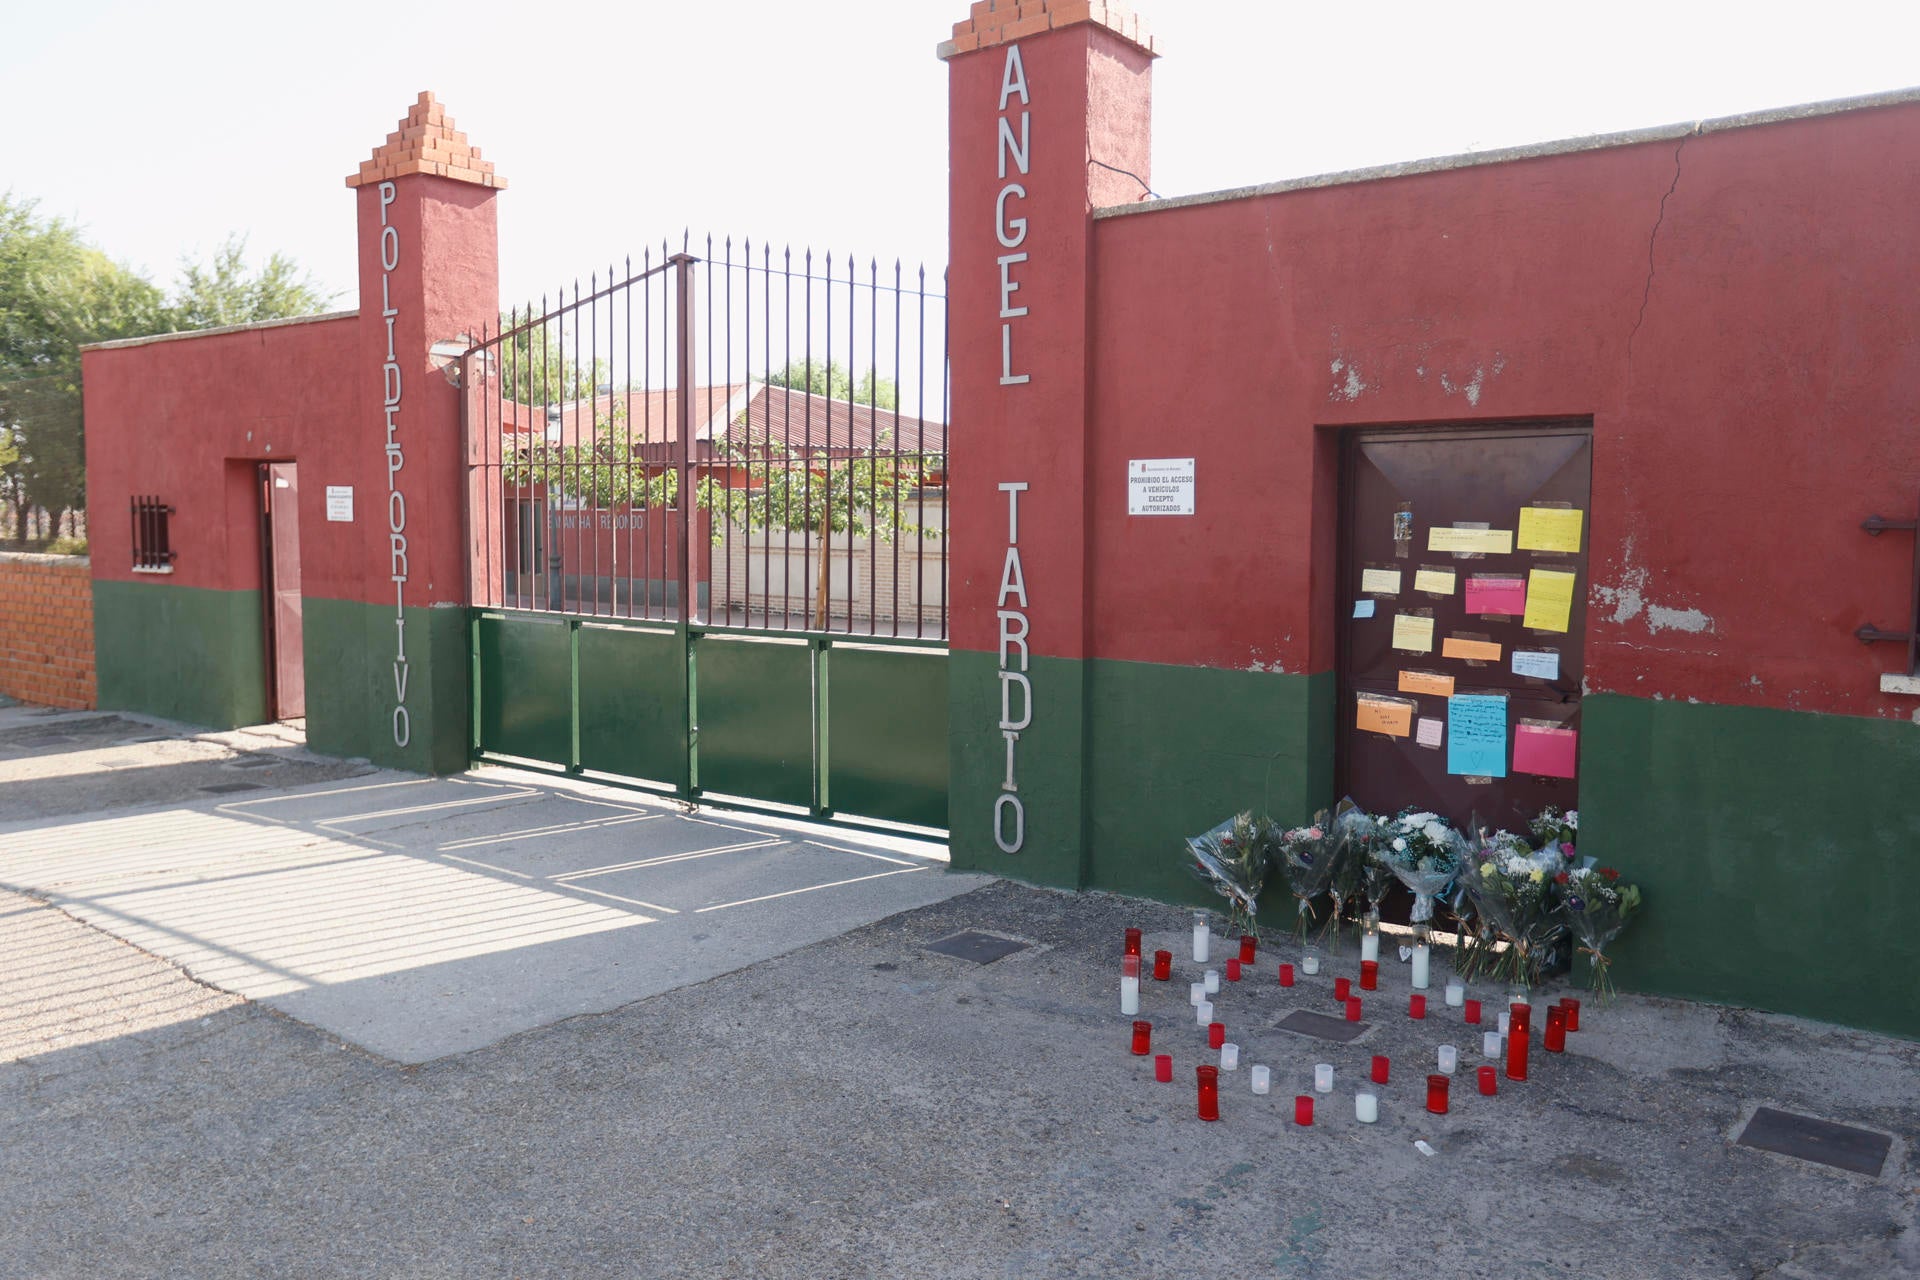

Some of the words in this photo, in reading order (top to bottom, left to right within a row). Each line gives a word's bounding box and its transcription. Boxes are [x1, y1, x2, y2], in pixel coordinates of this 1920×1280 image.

[995, 43, 1030, 386] ANGEL
[378, 181, 410, 748] POLIDEPORTIVO
[548, 514, 591, 529] SANHA
[993, 481, 1032, 855] TARDIO
